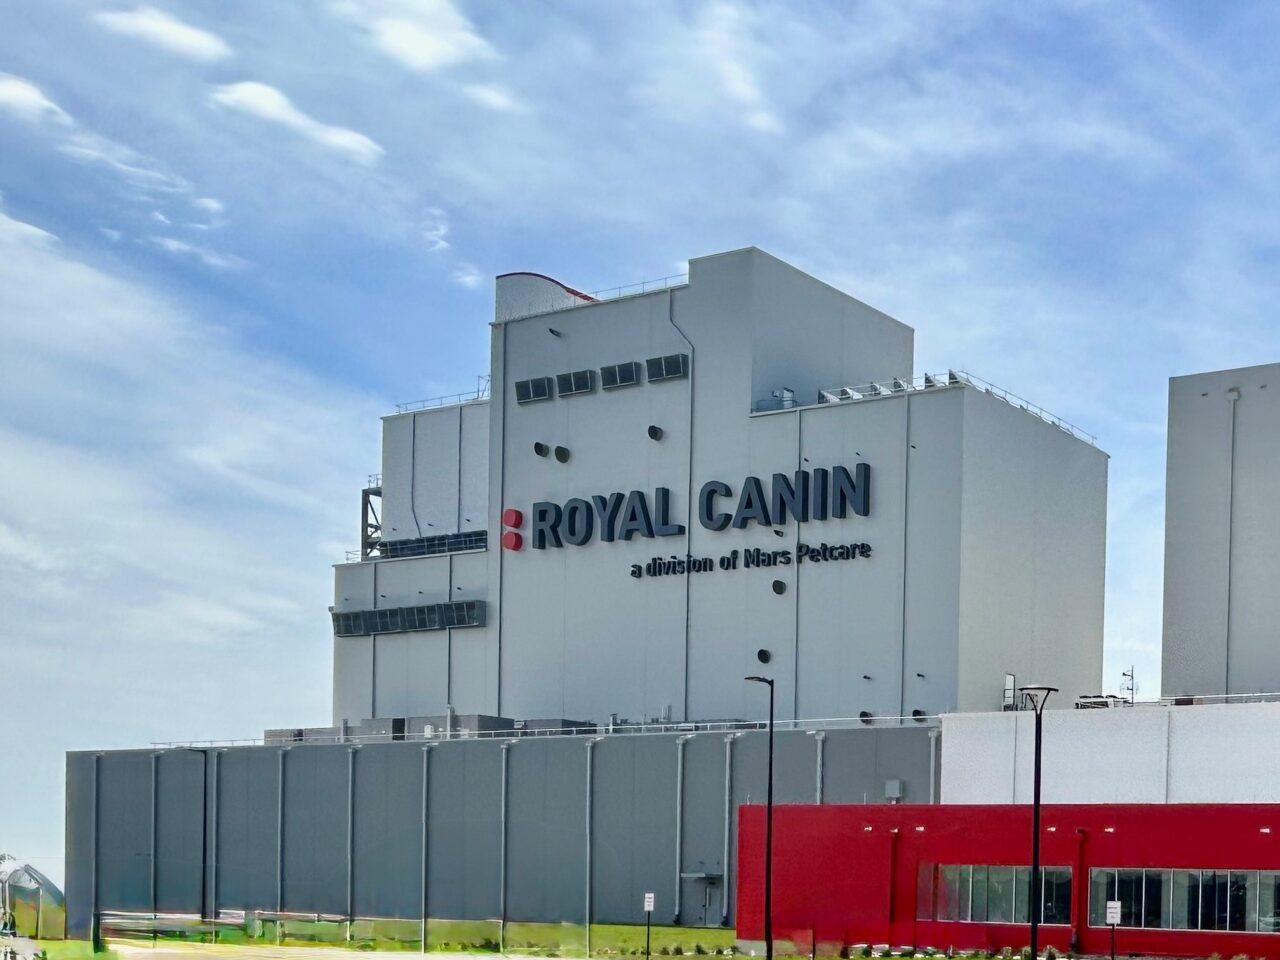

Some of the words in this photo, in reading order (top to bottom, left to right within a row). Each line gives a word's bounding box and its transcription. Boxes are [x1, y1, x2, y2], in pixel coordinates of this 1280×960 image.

[532, 487, 686, 550] ROYAL
[698, 463, 871, 531] CANIN
[630, 563, 643, 578] a
[646, 555, 714, 577] division
[719, 549, 739, 570] of
[744, 547, 791, 568] Mars
[797, 542, 873, 564] Petcare
